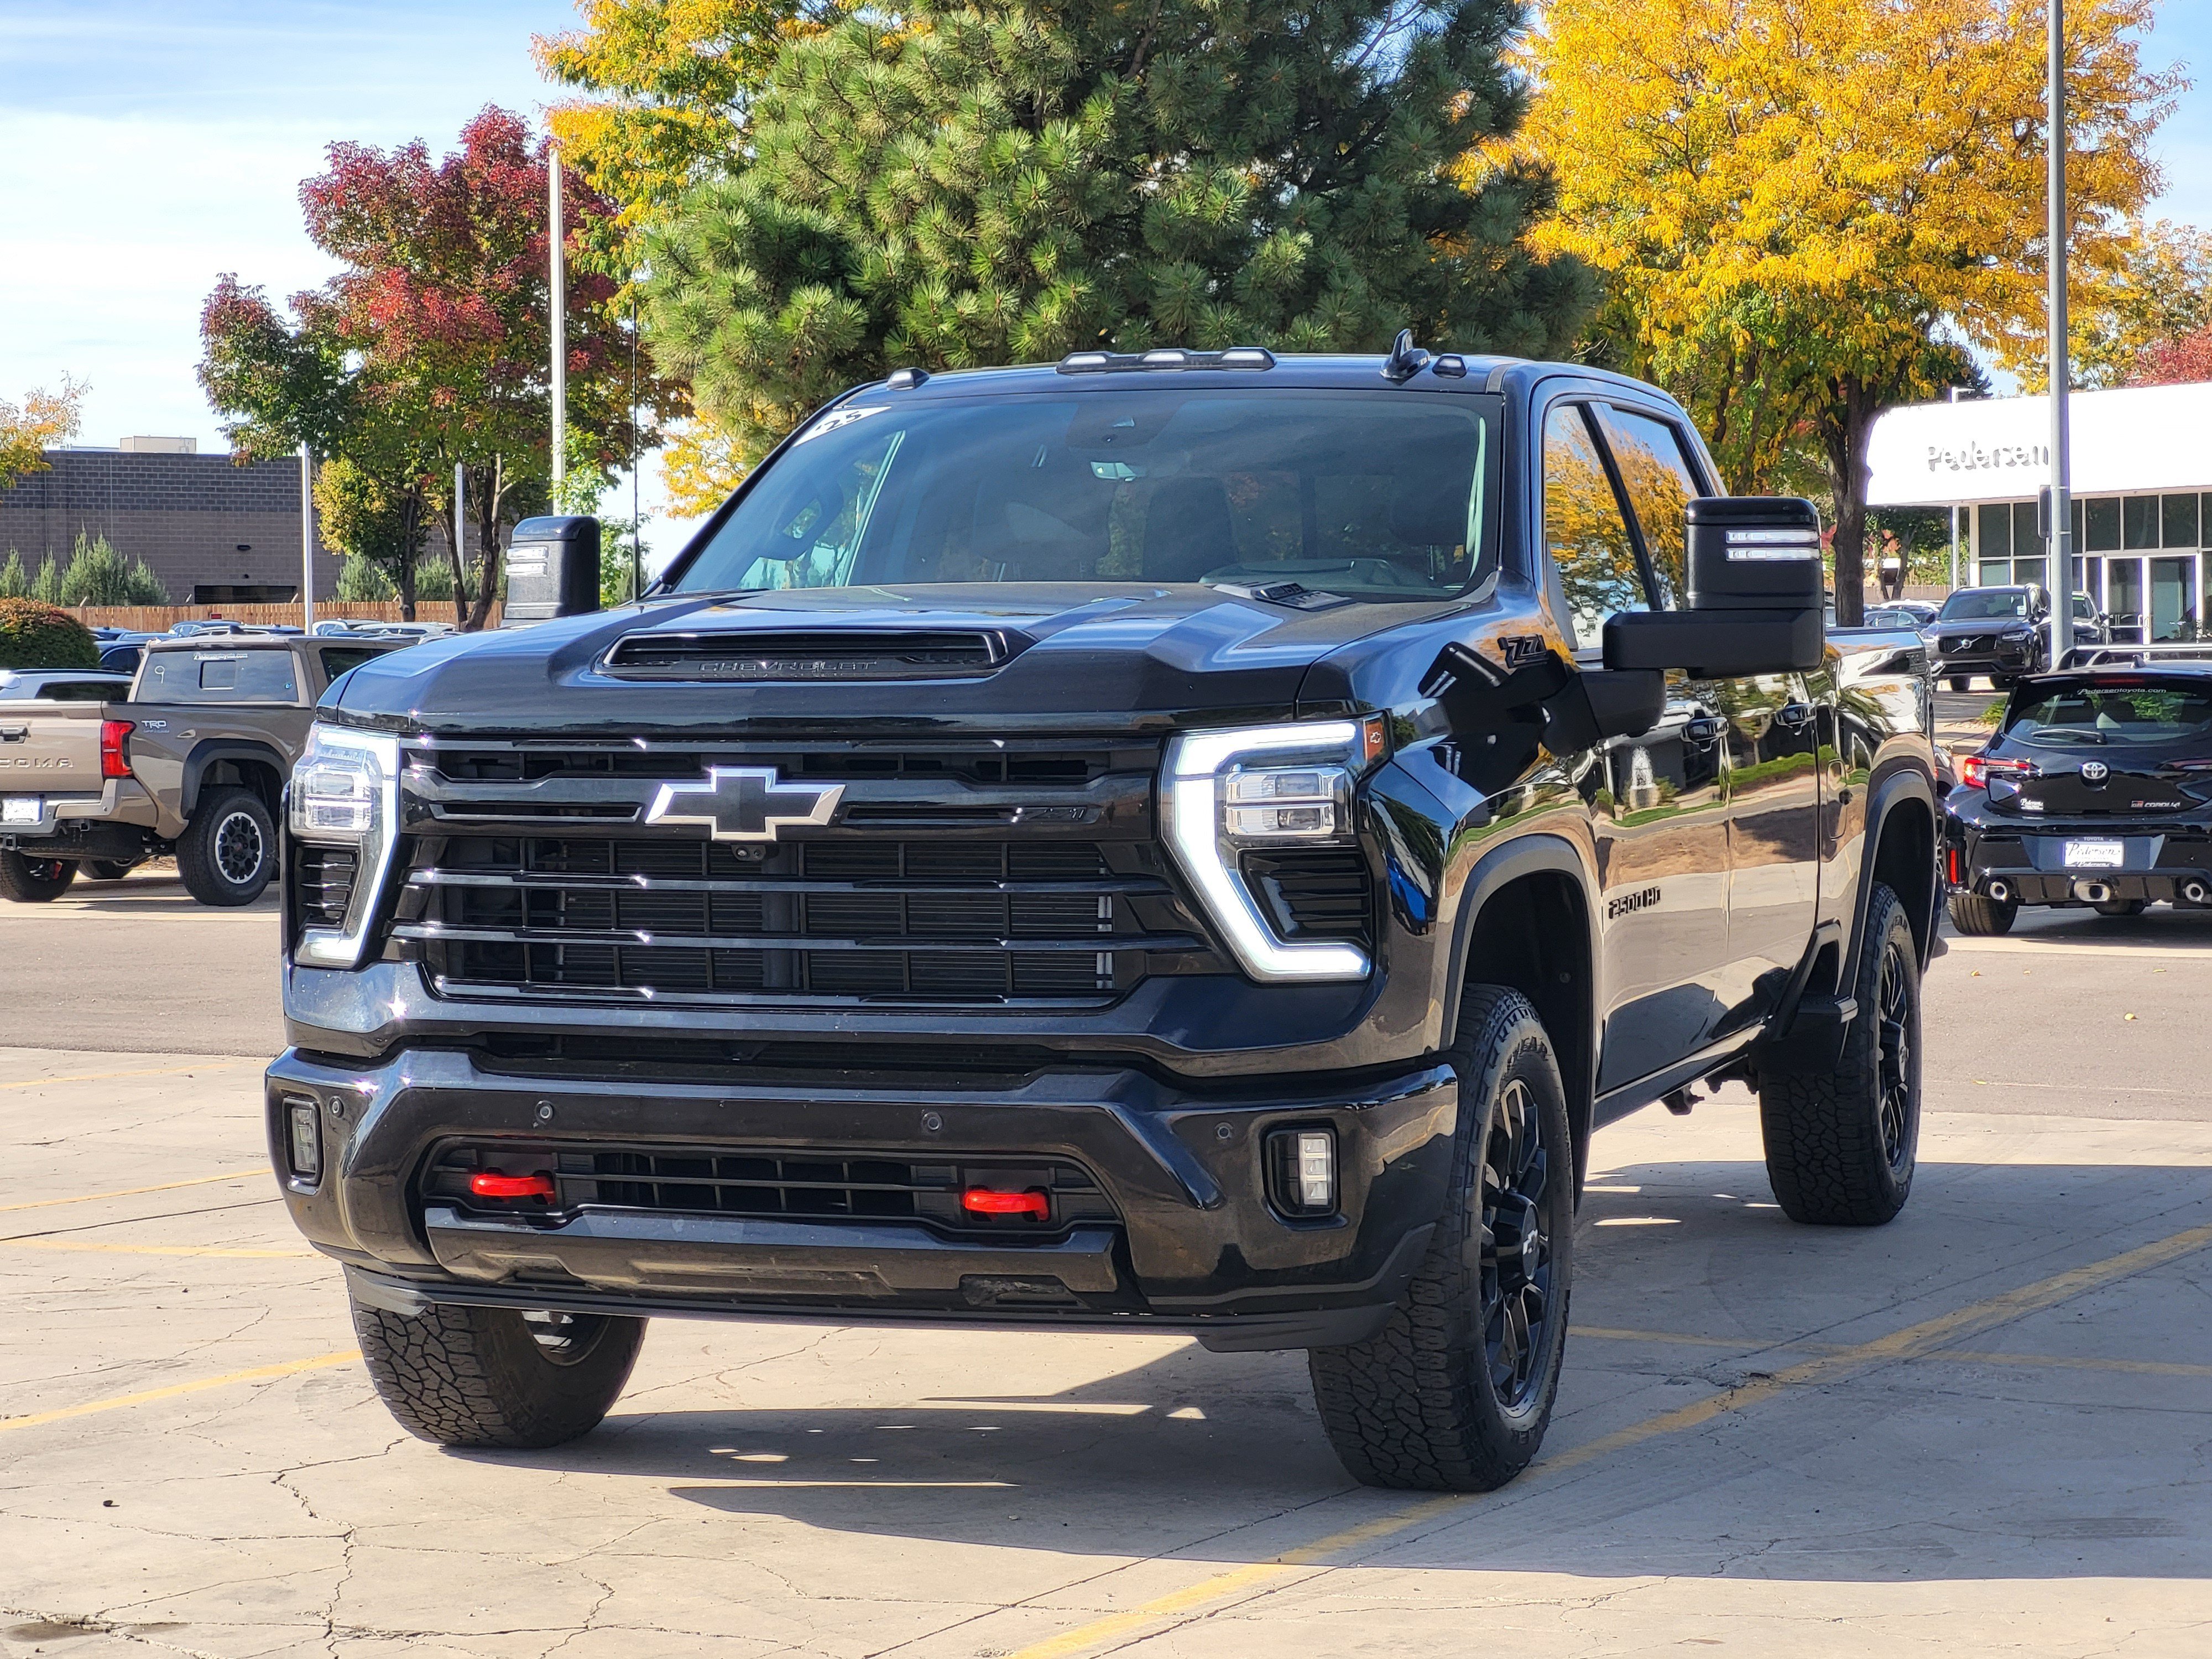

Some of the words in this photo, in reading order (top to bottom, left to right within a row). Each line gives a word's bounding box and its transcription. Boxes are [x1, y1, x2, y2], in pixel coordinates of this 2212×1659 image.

[1928, 441, 2049, 472] Pedersen
[698, 661, 877, 671] CHEVROLET
[1608, 892, 1642, 919] 2500
[1642, 886, 1661, 908] HD
